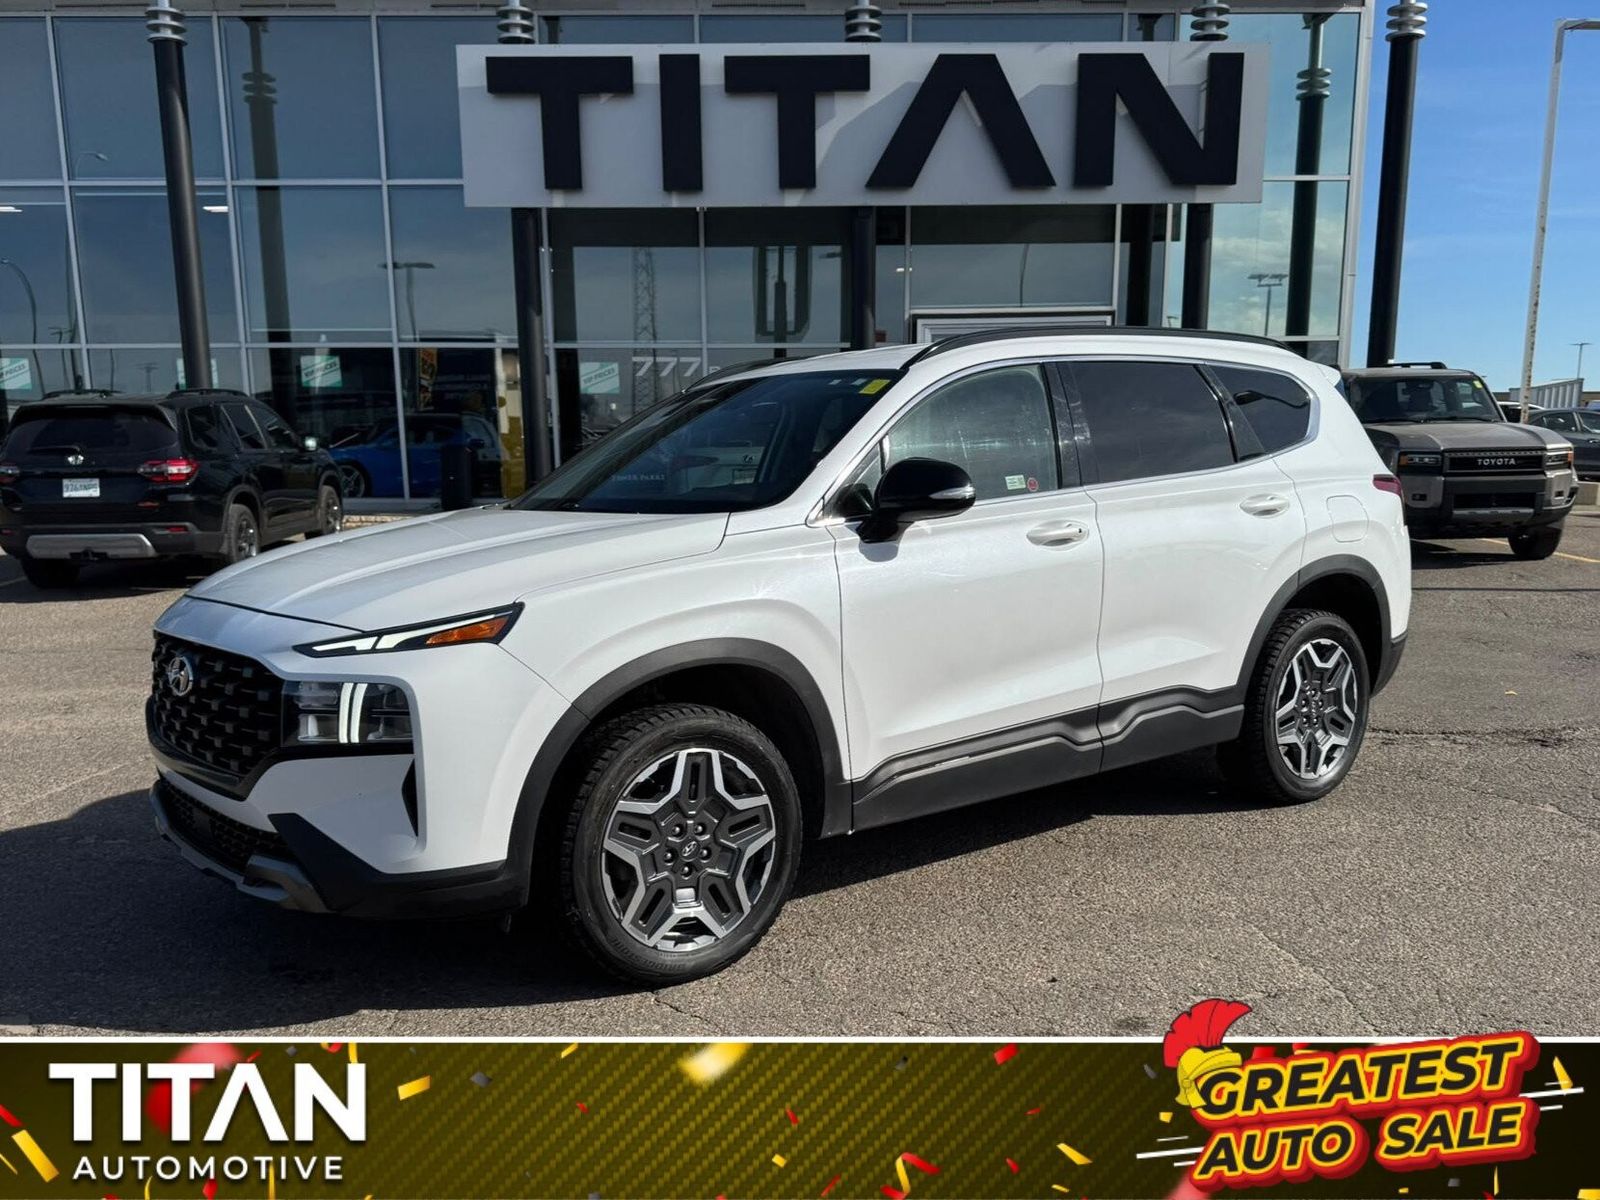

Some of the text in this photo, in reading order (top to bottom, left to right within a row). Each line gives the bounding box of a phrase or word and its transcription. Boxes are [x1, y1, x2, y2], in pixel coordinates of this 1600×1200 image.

[485, 52, 1244, 191] TITAN
[632, 357, 701, 377] 777
[1477, 458, 1516, 466] TOYOTA
